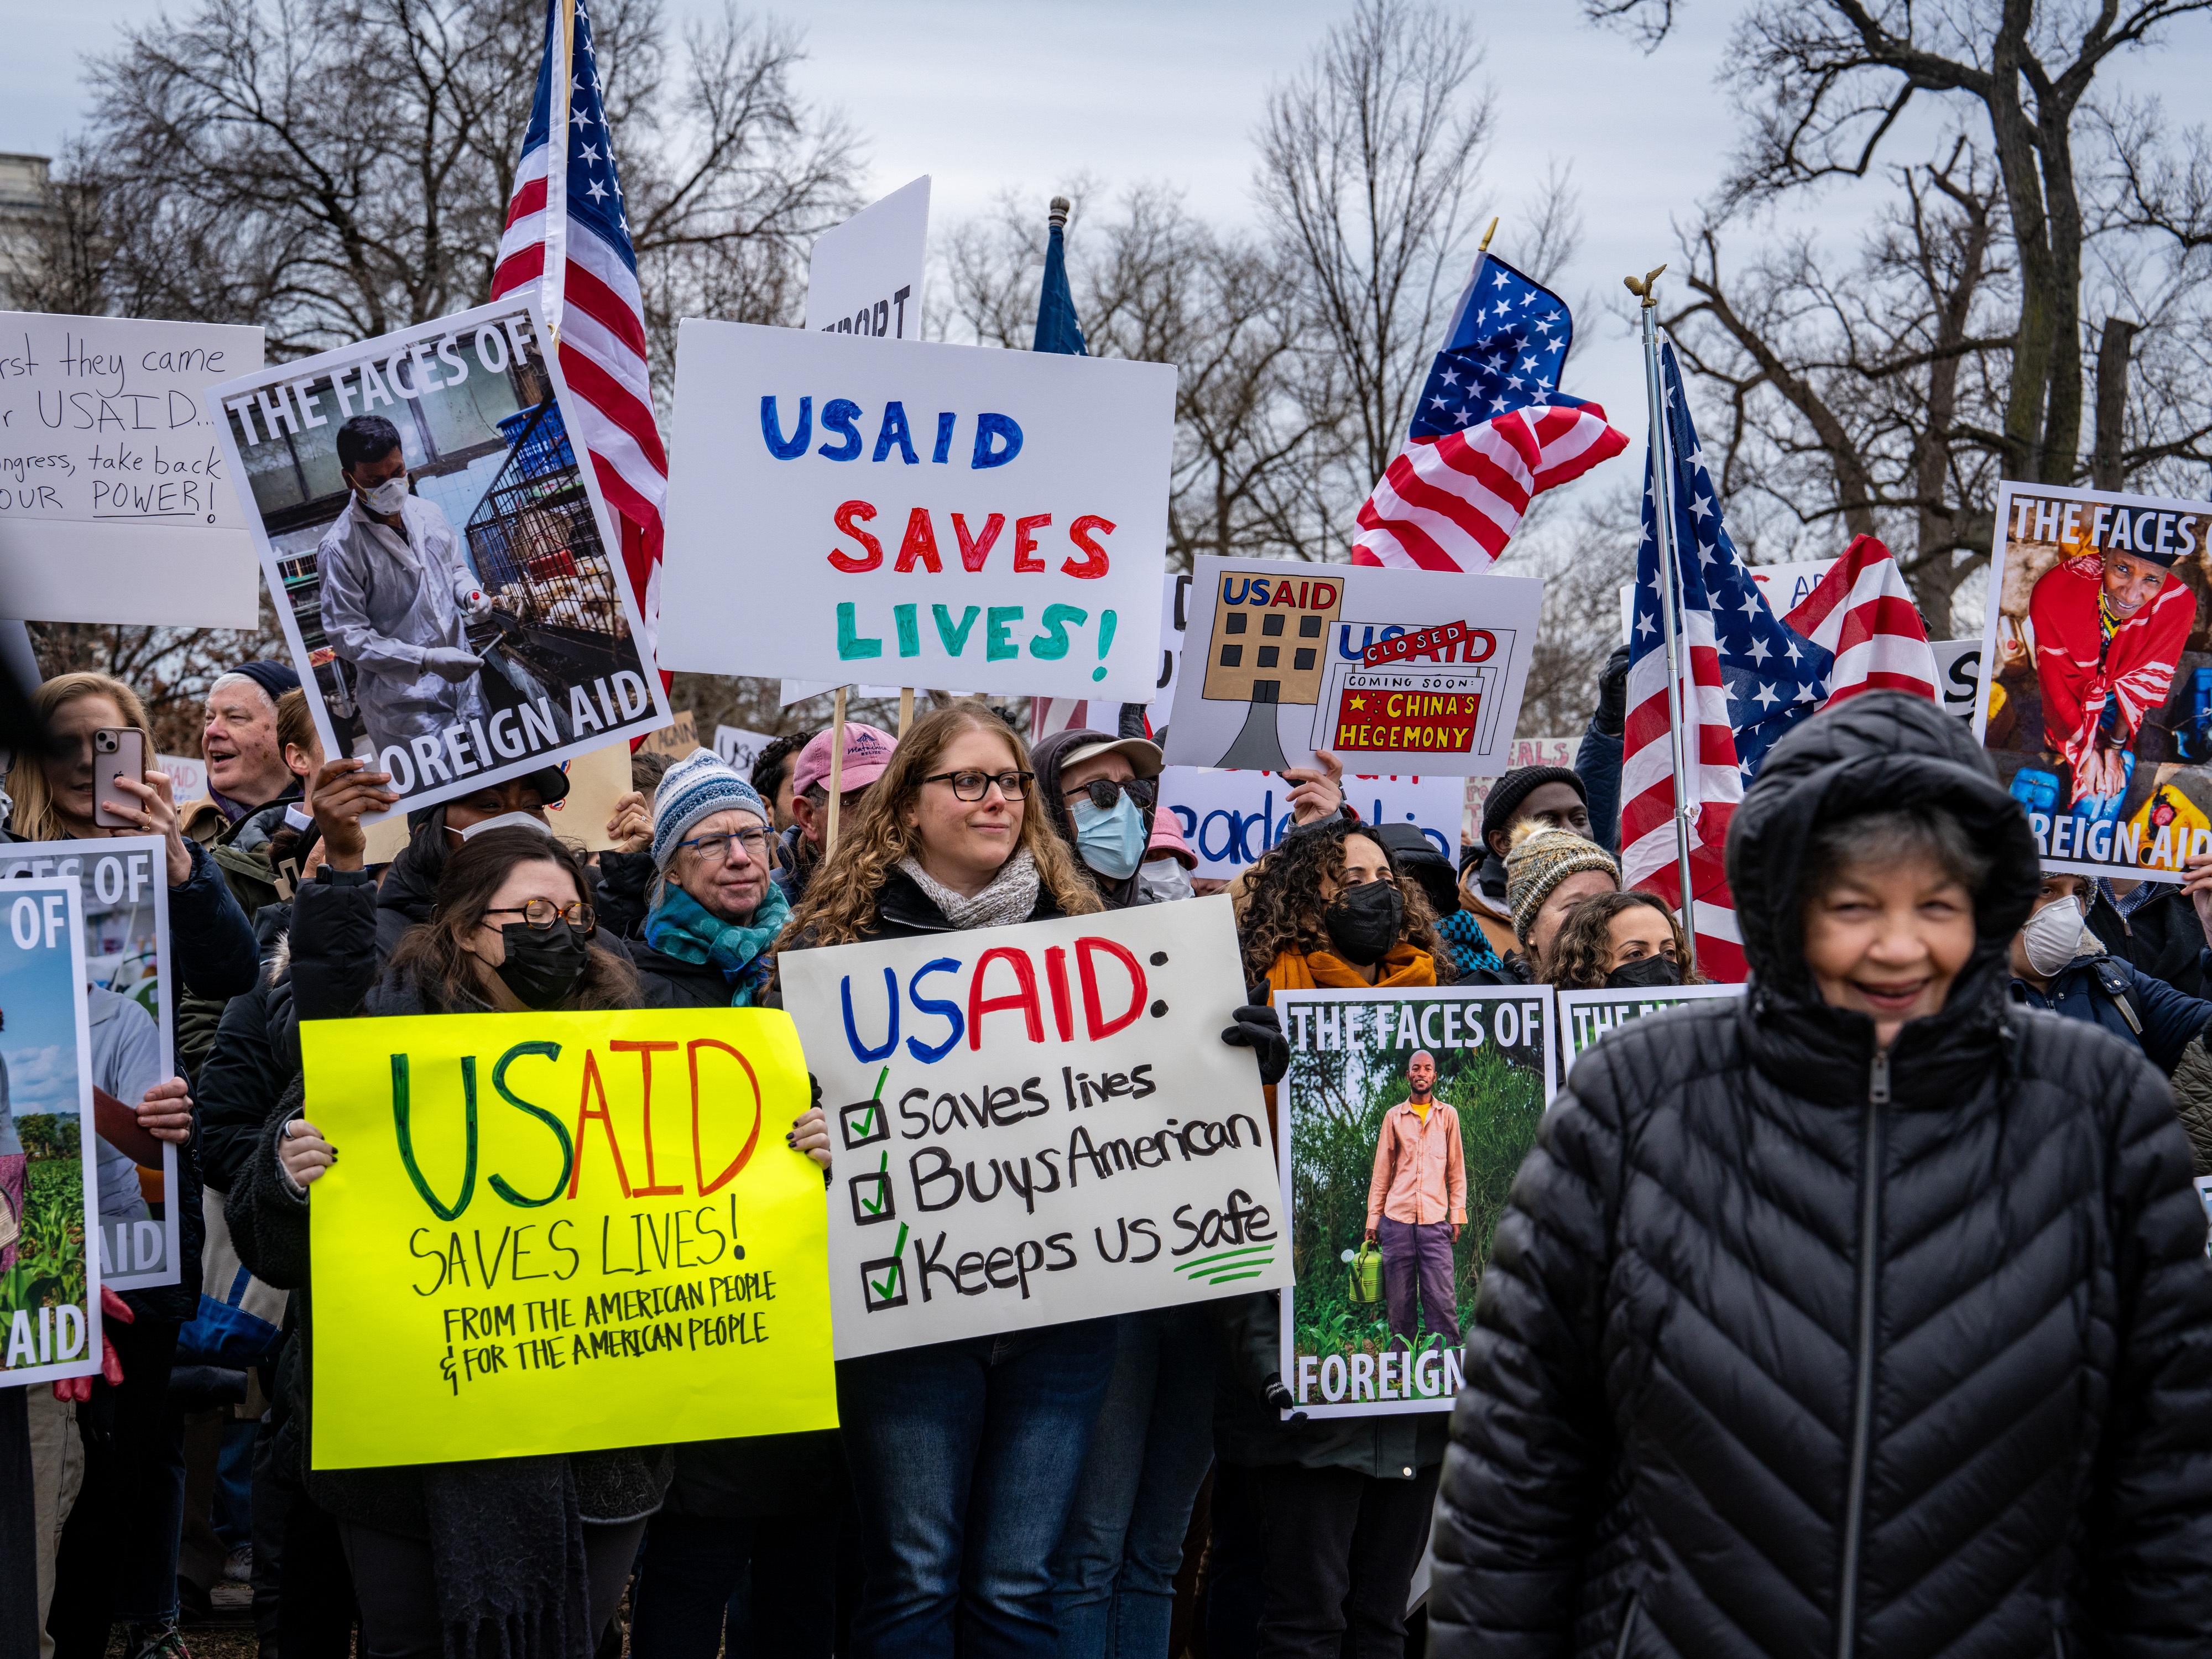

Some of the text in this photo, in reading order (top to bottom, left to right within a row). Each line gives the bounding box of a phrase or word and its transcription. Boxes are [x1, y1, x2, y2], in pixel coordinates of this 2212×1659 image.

[0, 332, 226, 398] rst they came
[227, 314, 532, 446] THE FACES OF
[0, 442, 221, 483] ngress, take back
[760, 395, 1024, 469] USAID
[93, 481, 216, 523] POWER!
[2013, 498, 2083, 544] THE
[2091, 506, 2197, 556] FACES
[827, 499, 1117, 580] SAVES
[1223, 577, 1337, 610] USAID
[837, 602, 1118, 682] LIVES!
[1366, 627, 1459, 661] CLOSED
[569, 670, 648, 737] AID
[1349, 676, 1474, 689] COMING SOON:
[1386, 693, 1475, 718] CHINA'S
[1338, 724, 1470, 748] HEGEMONY
[2028, 812, 2141, 864] REIGN
[95, 855, 148, 904] OF
[11, 896, 65, 950] OF
[840, 937, 1170, 1064] USAID:
[1290, 1002, 1539, 1051] THE FACES OF
[1062, 1064, 1157, 1112] lives
[390, 1038, 761, 1221] USAID
[909, 1113, 1261, 1214] Buys American
[409, 1193, 745, 1296] SAVES LIVES!
[914, 1231, 1077, 1302] Keeps
[6, 1304, 85, 1367] AID
[444, 1271, 776, 1343] FROM THE AMERICAN PEOPLE
[440, 1312, 769, 1396] & FOR THE AMERICAN PEOPLE
